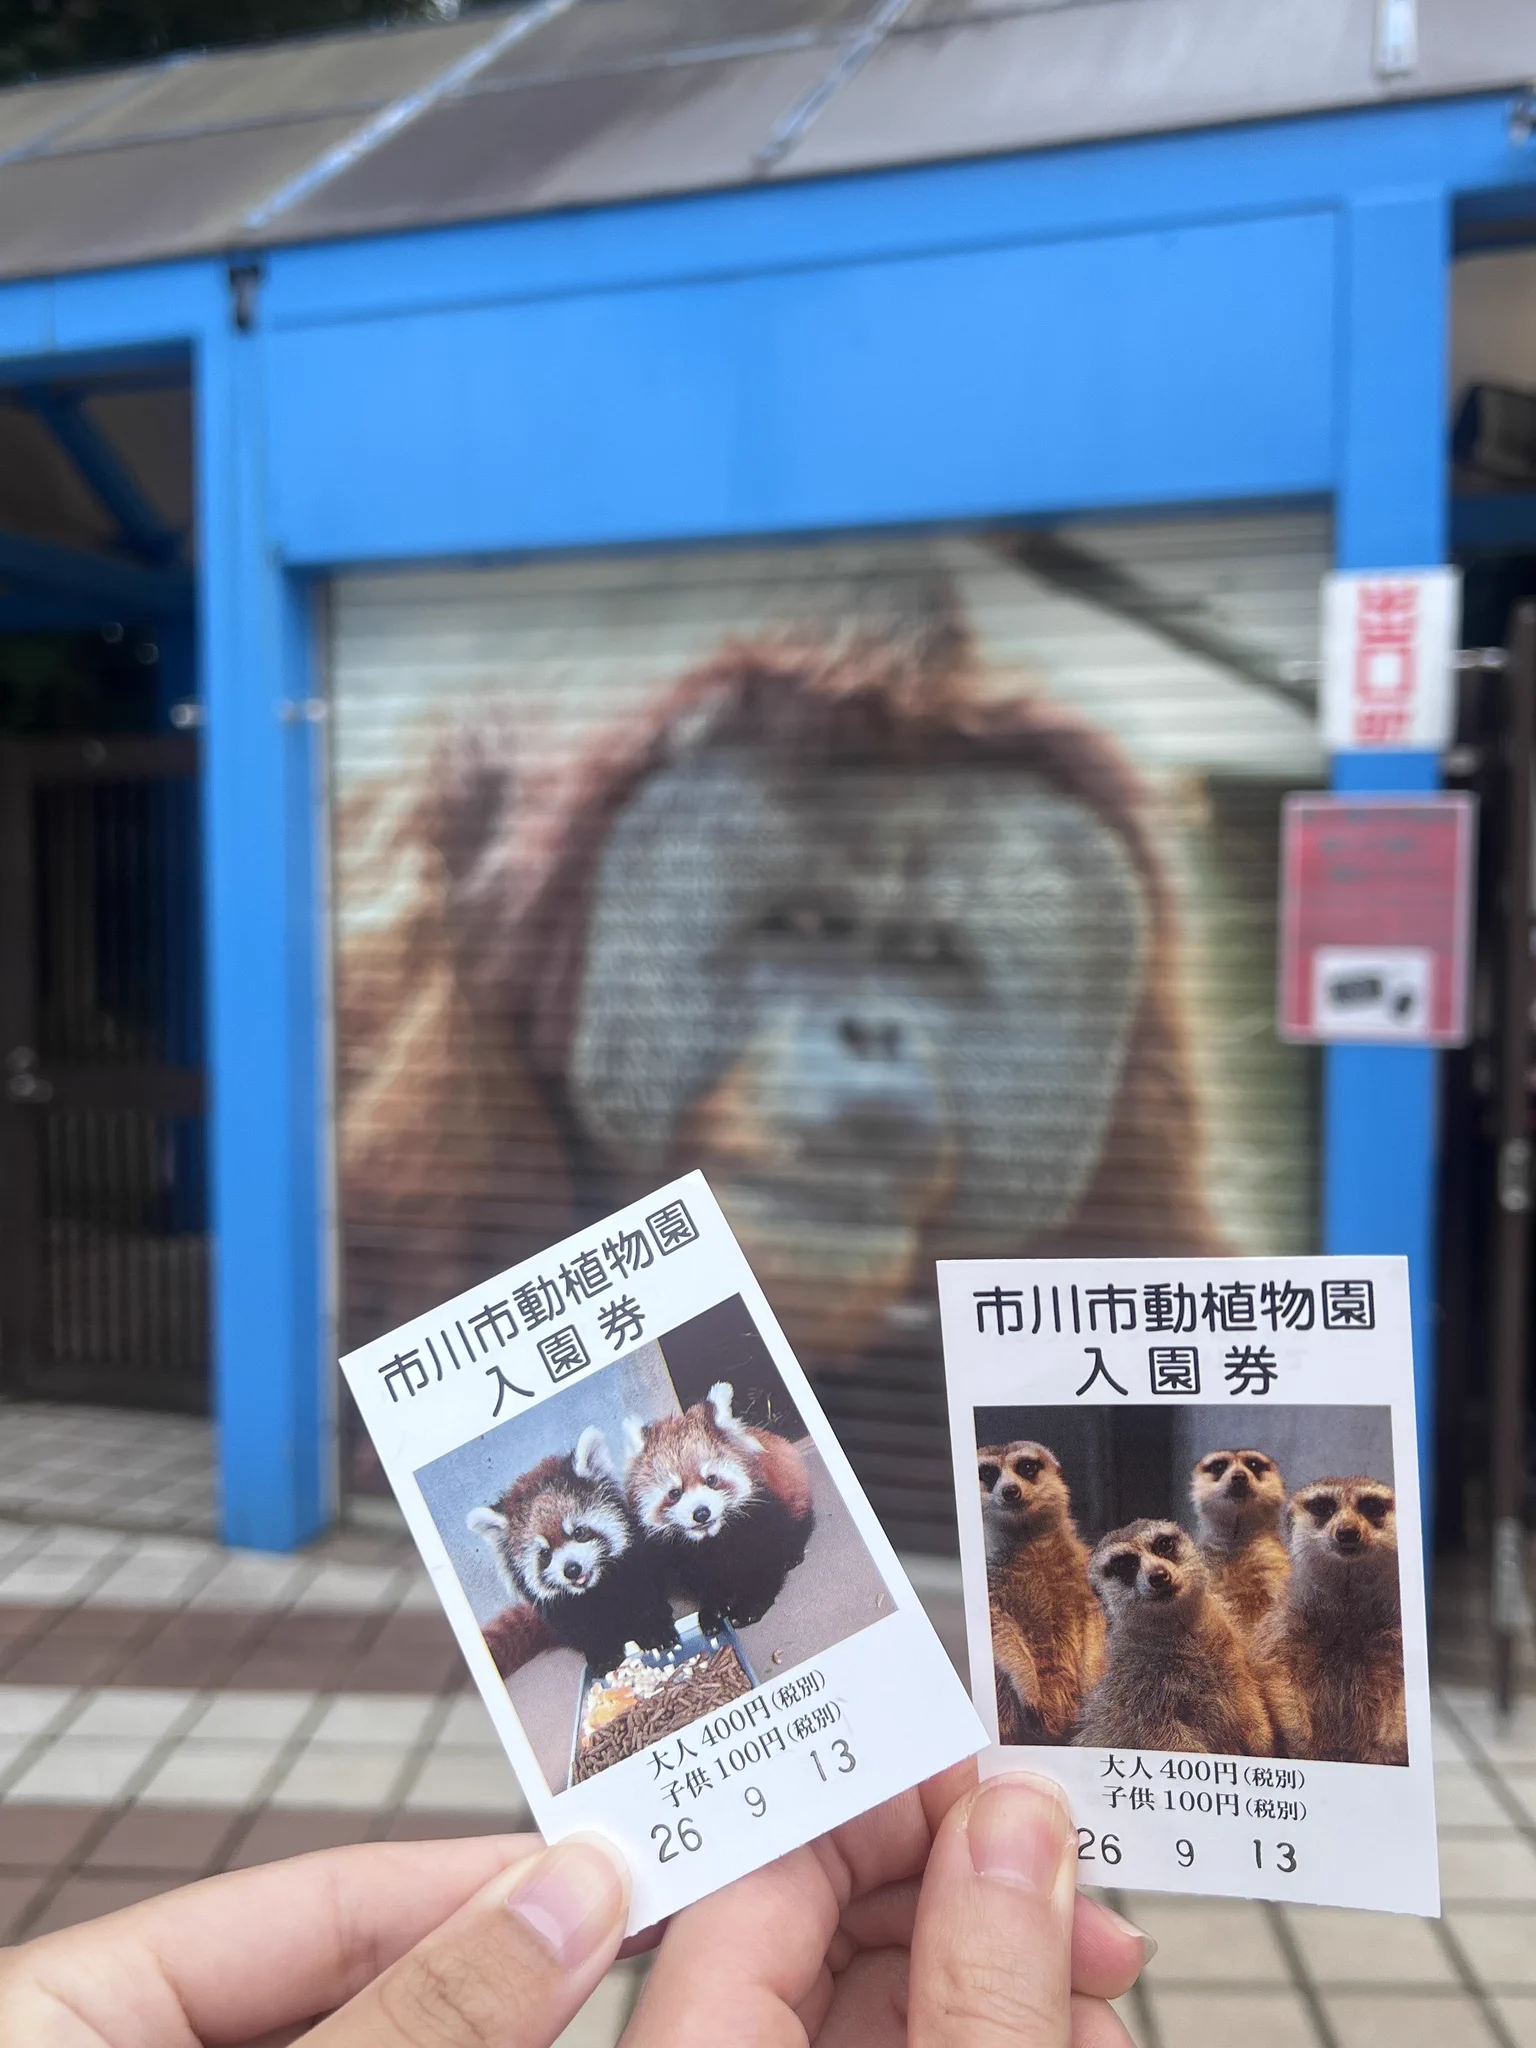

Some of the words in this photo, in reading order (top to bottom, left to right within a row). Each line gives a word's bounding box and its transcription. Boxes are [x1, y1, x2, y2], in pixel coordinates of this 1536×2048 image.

[378, 1199, 700, 1402] 市川市動植物園
[972, 1279, 1376, 1335] 市川市動植物園
[485, 1294, 646, 1418] 入園券
[1075, 1344, 1279, 1396] 入園券
[650, 1817, 703, 1863] 26
[744, 1786, 767, 1818] 9
[811, 1738, 857, 1782] 13
[1077, 1827, 1123, 1865] 26
[1175, 1838, 1195, 1868] 9
[1253, 1838, 1298, 1873] 13
